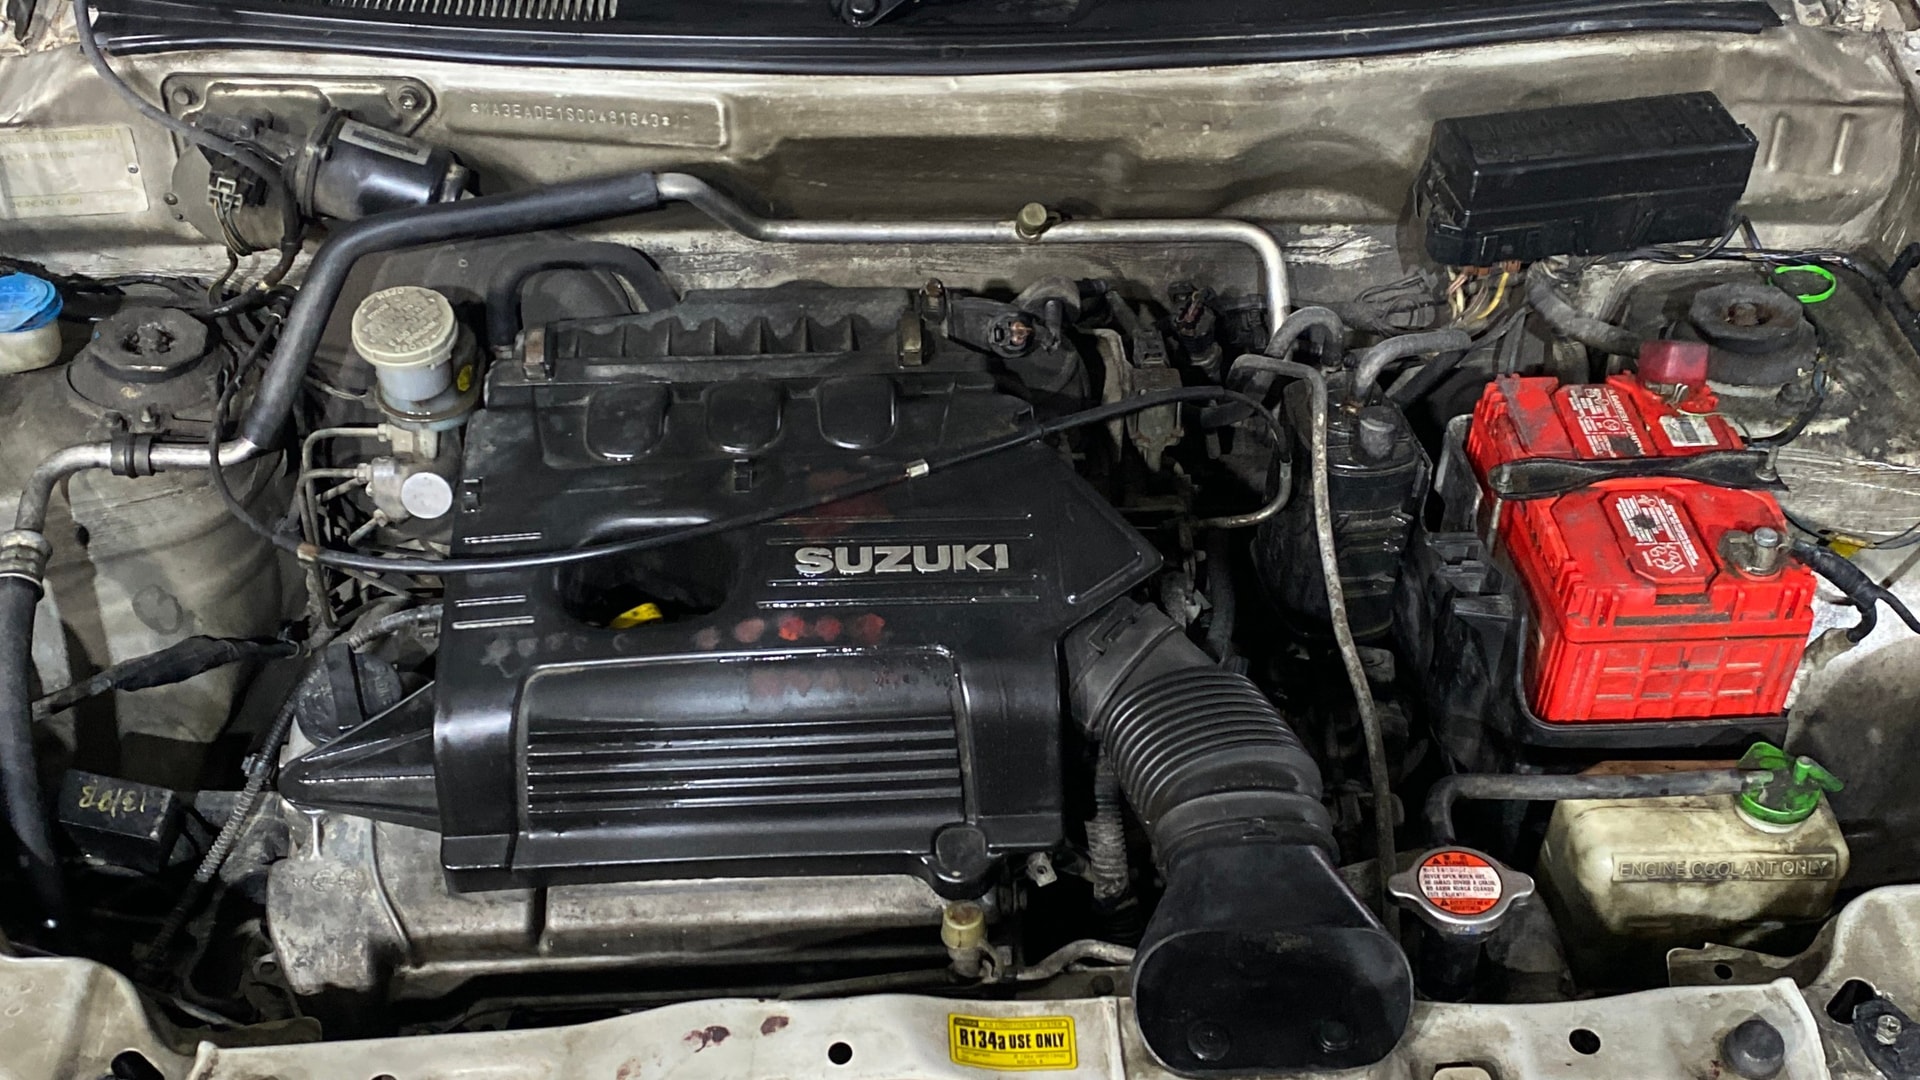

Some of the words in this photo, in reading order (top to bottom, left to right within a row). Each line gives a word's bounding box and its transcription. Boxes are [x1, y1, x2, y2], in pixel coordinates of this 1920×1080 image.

[795, 543, 1009, 574] SUZUKI
[1619, 861, 1686, 877] ENGINE
[1691, 860, 1777, 877] COOLANT
[1781, 860, 1829, 877] ONLY
[959, 1028, 1006, 1050] R134a
[1008, 1034, 1032, 1049] USE
[1035, 1032, 1065, 1048] ONLY
